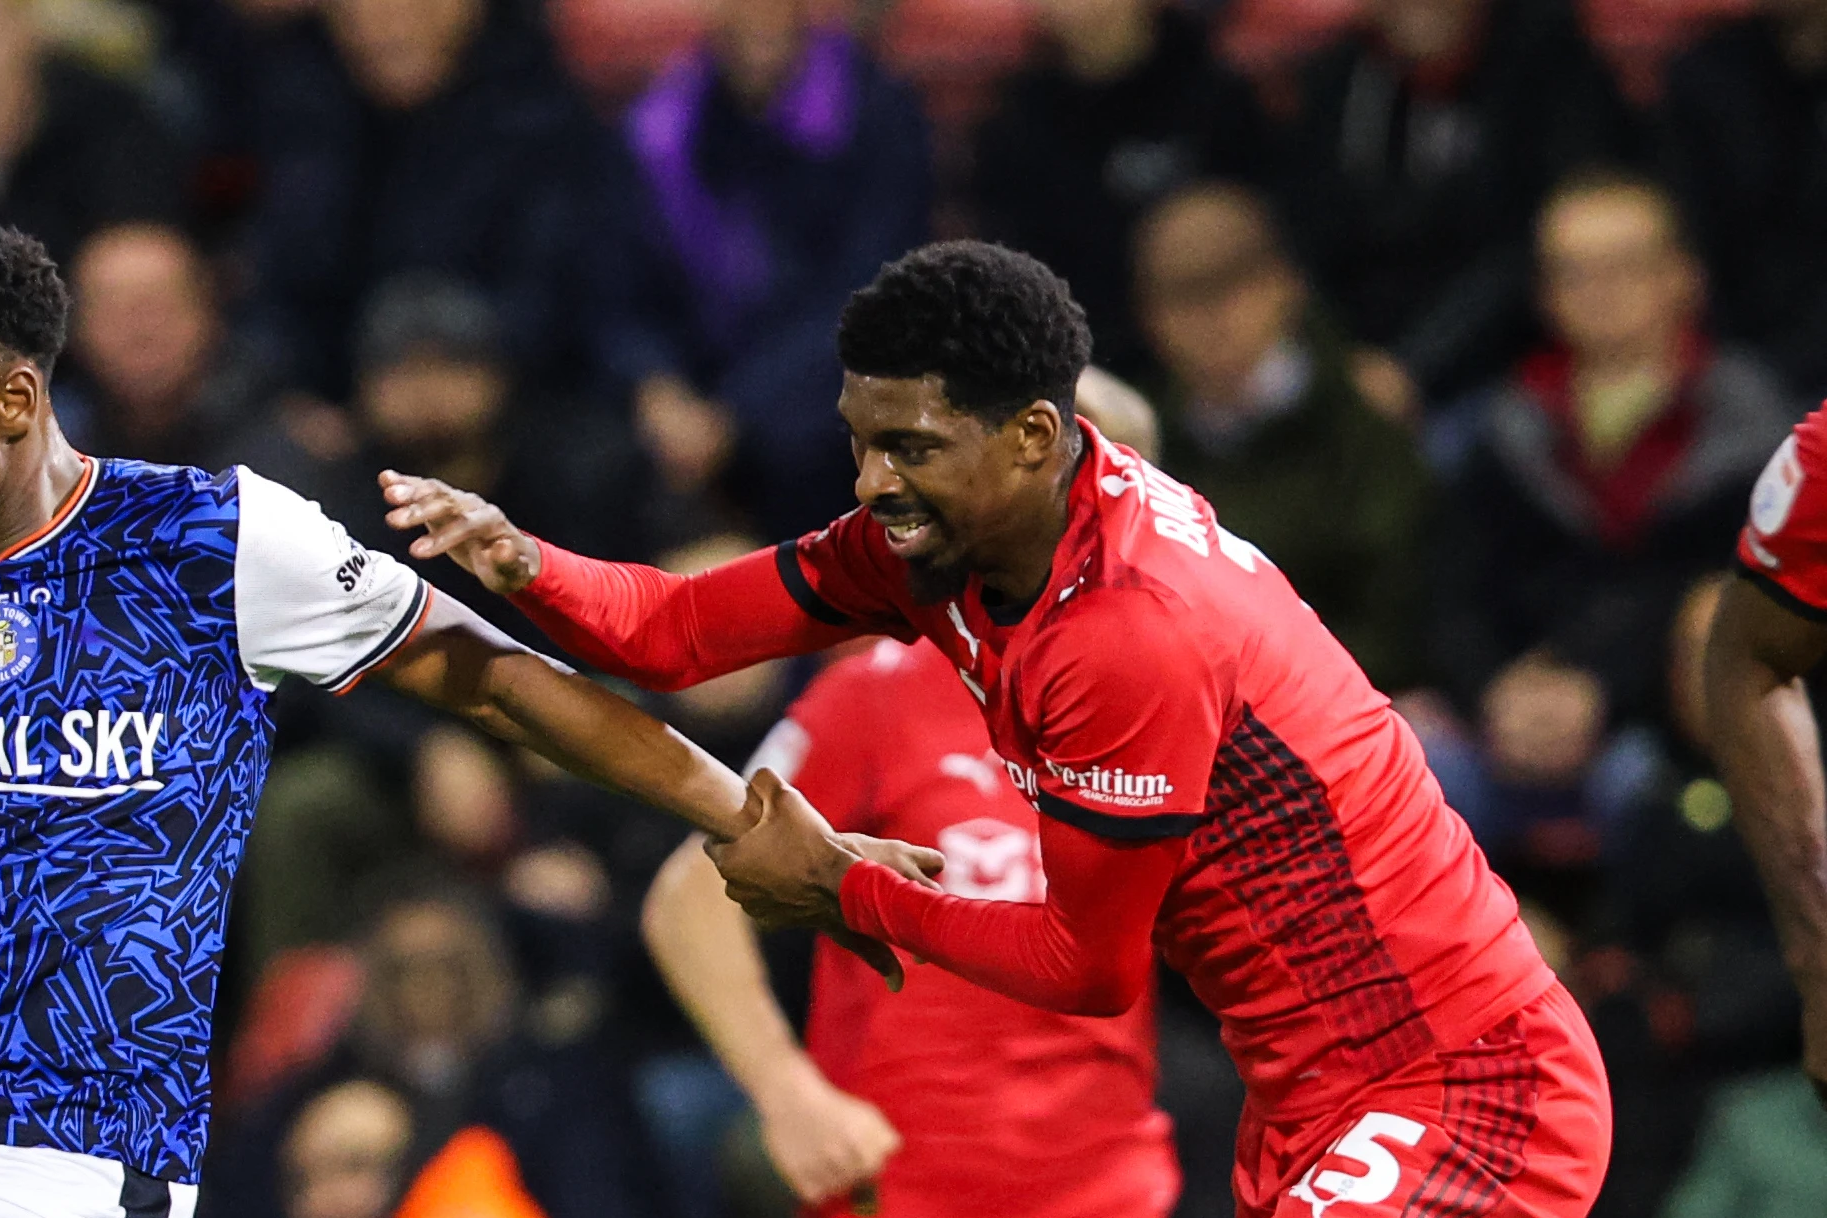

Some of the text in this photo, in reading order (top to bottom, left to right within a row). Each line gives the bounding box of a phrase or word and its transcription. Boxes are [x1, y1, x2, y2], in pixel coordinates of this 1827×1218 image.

[3, 607, 32, 628] TOWN
[10, 654, 32, 676] CLUB
[60, 709, 164, 780] SKY
